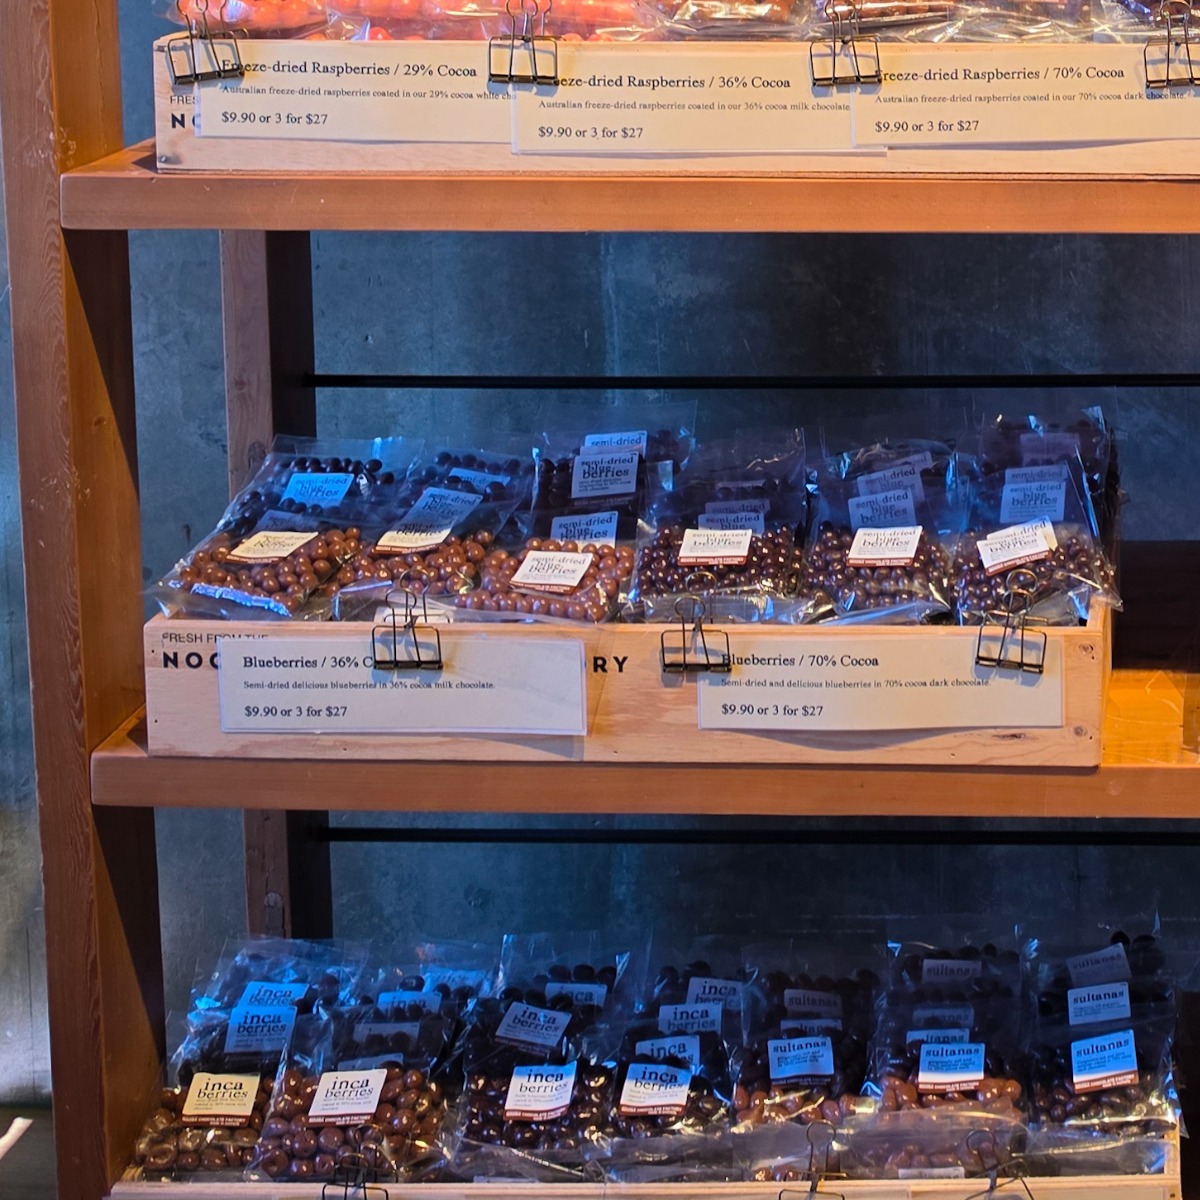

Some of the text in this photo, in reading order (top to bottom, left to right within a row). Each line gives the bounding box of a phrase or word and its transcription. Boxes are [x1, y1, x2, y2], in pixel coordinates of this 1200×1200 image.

[311, 61, 390, 77] Raspberries
[393, 63, 399, 75] /
[403, 63, 433, 76] 29%
[437, 64, 477, 77] Cocoa
[962, 67, 1040, 83] Raspberries
[1043, 67, 1049, 79] /
[1052, 66, 1082, 79] 70%
[1085, 66, 1125, 78] Cocoa
[221, 111, 327, 125] $9.90 or 3 for $27
[798, 654, 804, 666] /
[807, 654, 836, 666] 70%
[840, 654, 879, 667] Cocoa
[244, 705, 347, 717] $9.90 or 3 for $27
[926, 1044, 980, 1057] sultanas
[1076, 1037, 1130, 1058] sultanas
[204, 1077, 244, 1091] inca
[332, 1076, 370, 1091] inca
[197, 1089, 249, 1100] berries
[325, 1088, 374, 1099] berries
